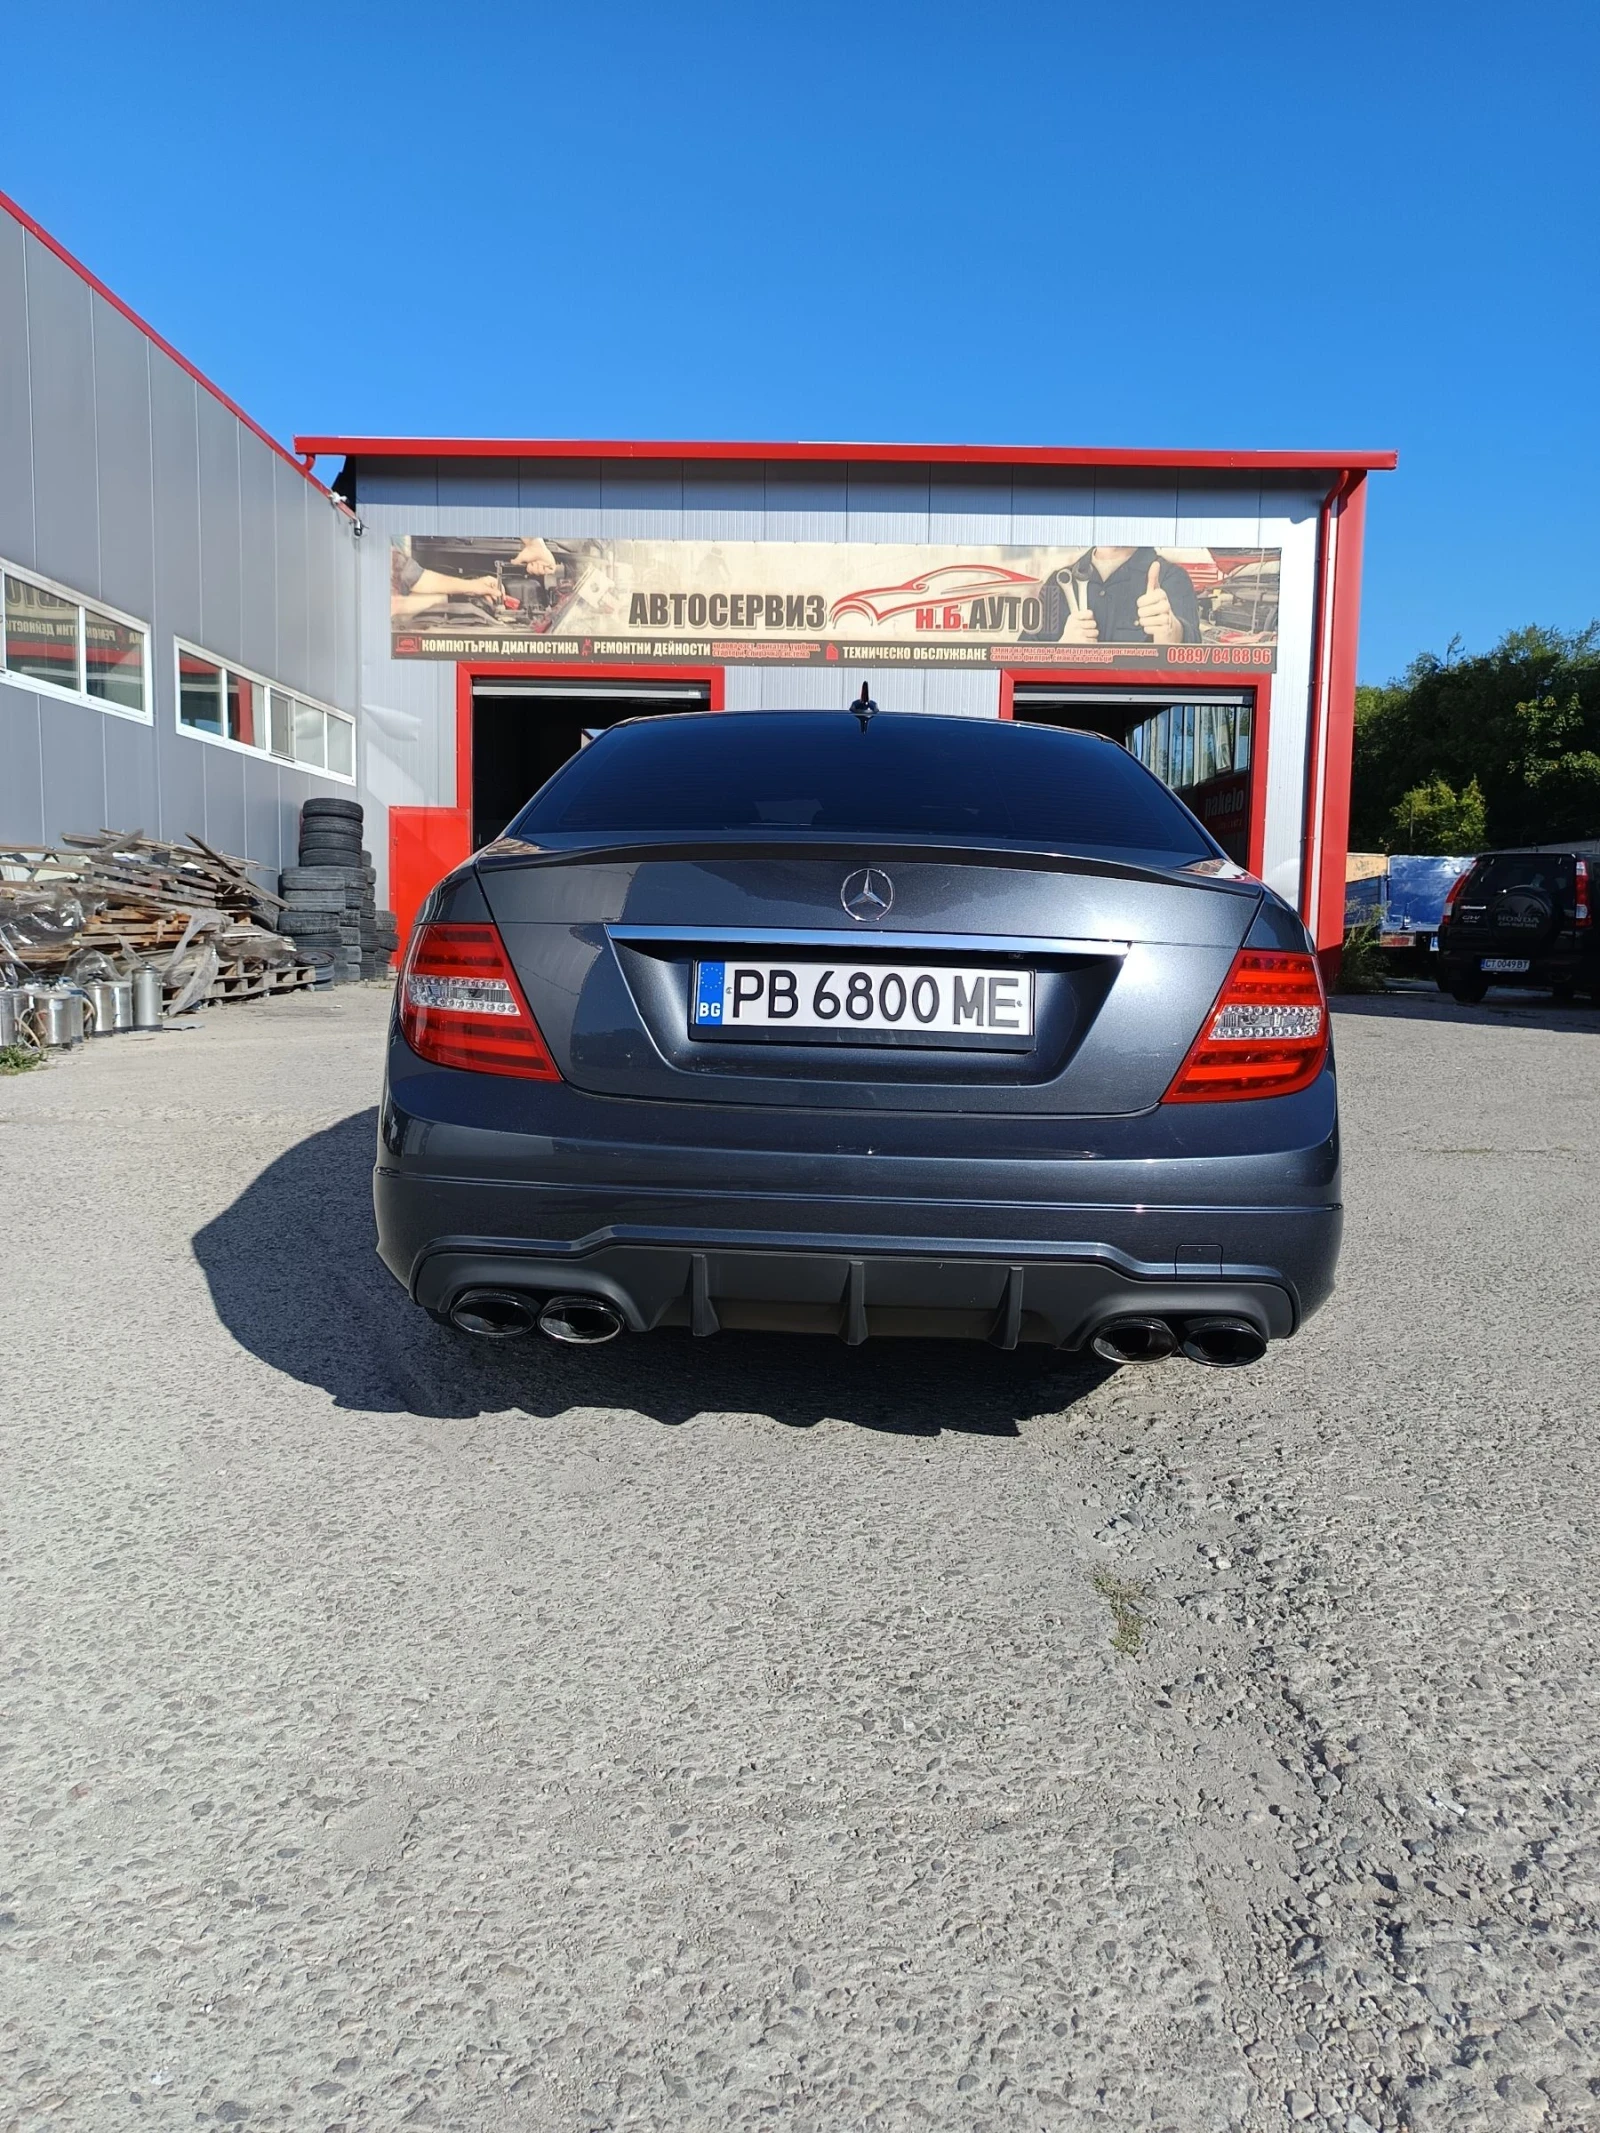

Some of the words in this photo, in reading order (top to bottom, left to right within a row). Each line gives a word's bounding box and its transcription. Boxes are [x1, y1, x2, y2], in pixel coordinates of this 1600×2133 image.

[629, 593, 825, 629] АВТОСЕРВИЗ
[422, 639, 499, 653] КОМПЮТЪРНА
[501, 641, 579, 655] ДИАГНОСТИКА
[593, 641, 651, 655] РЕМОНТНИ
[653, 641, 711, 656] ДЕЙНОСТИ
[842, 646, 911, 660] ТЕХНИЧЕСКО
[913, 647, 988, 661] ОБСЛУЖВАНЕ
[1167, 647, 1210, 664] 0889/
[1212, 647, 1230, 664] 84
[1232, 647, 1251, 664] 88
[1252, 648, 1272, 664] 96
[732, 969, 799, 1019] PB
[812, 970, 940, 1024] 6800
[953, 975, 1020, 1029] ME
[699, 1002, 721, 1018] BG
